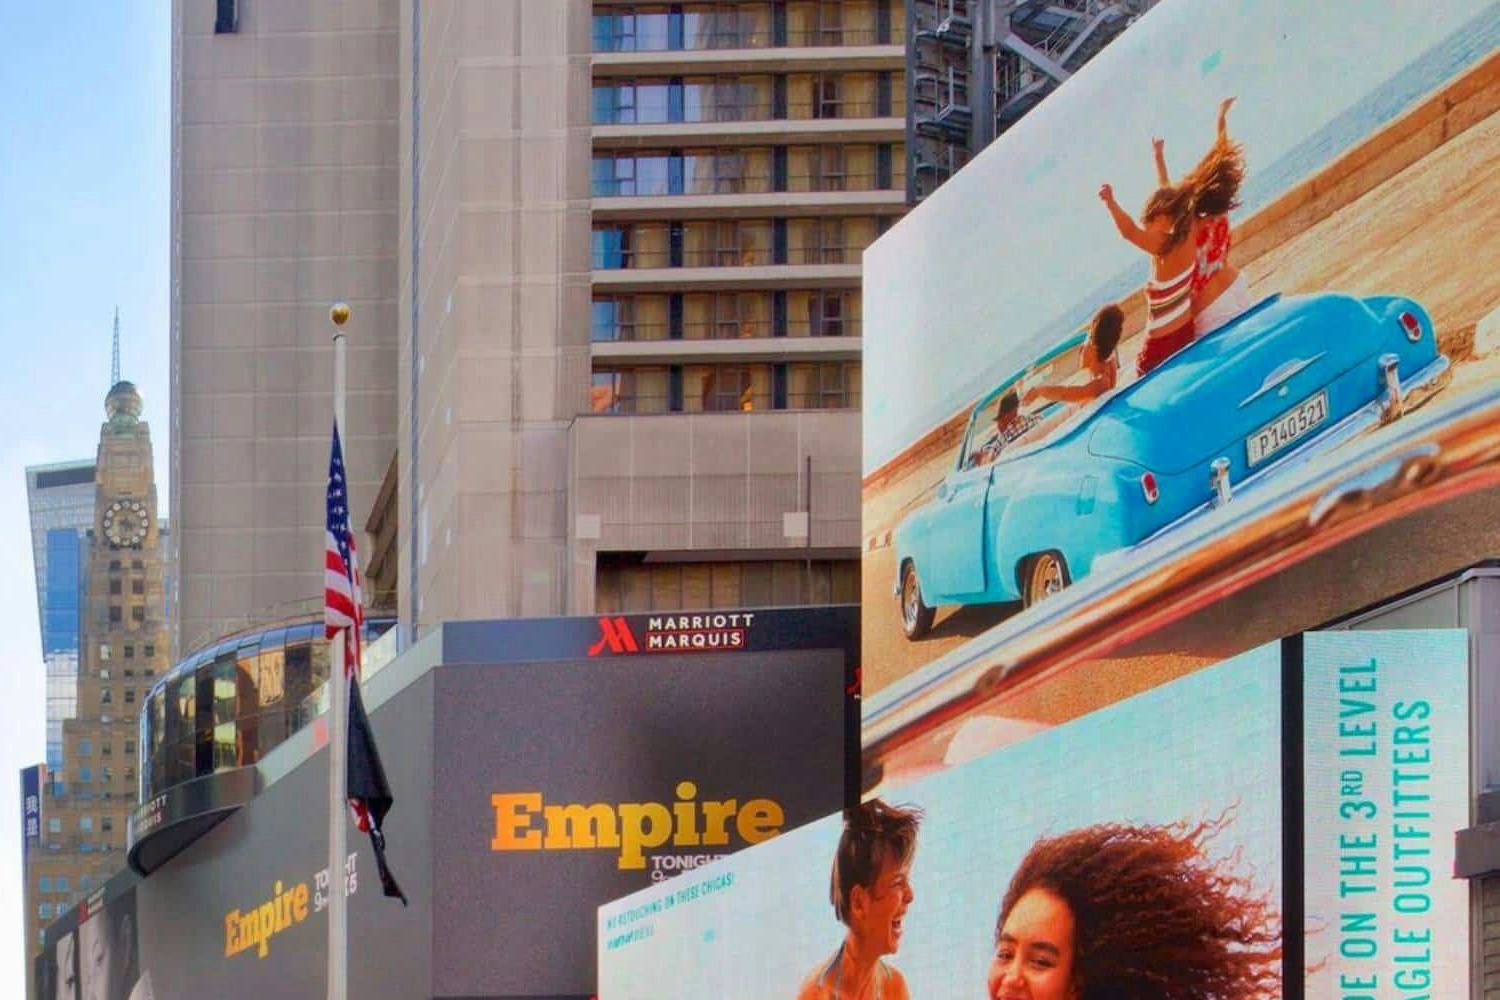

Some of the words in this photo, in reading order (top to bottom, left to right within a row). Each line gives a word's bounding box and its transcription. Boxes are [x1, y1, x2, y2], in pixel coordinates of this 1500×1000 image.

[649, 614, 755, 630] MARRIOTT
[649, 632, 742, 648] MARQUIS
[1339, 658, 1377, 756] LEVEL
[491, 781, 786, 869] Empire
[1392, 699, 1431, 914] OUTFITTERS
[1340, 833, 1377, 898] THE
[225, 880, 309, 959] Empire
[1340, 912, 1377, 959] ON
